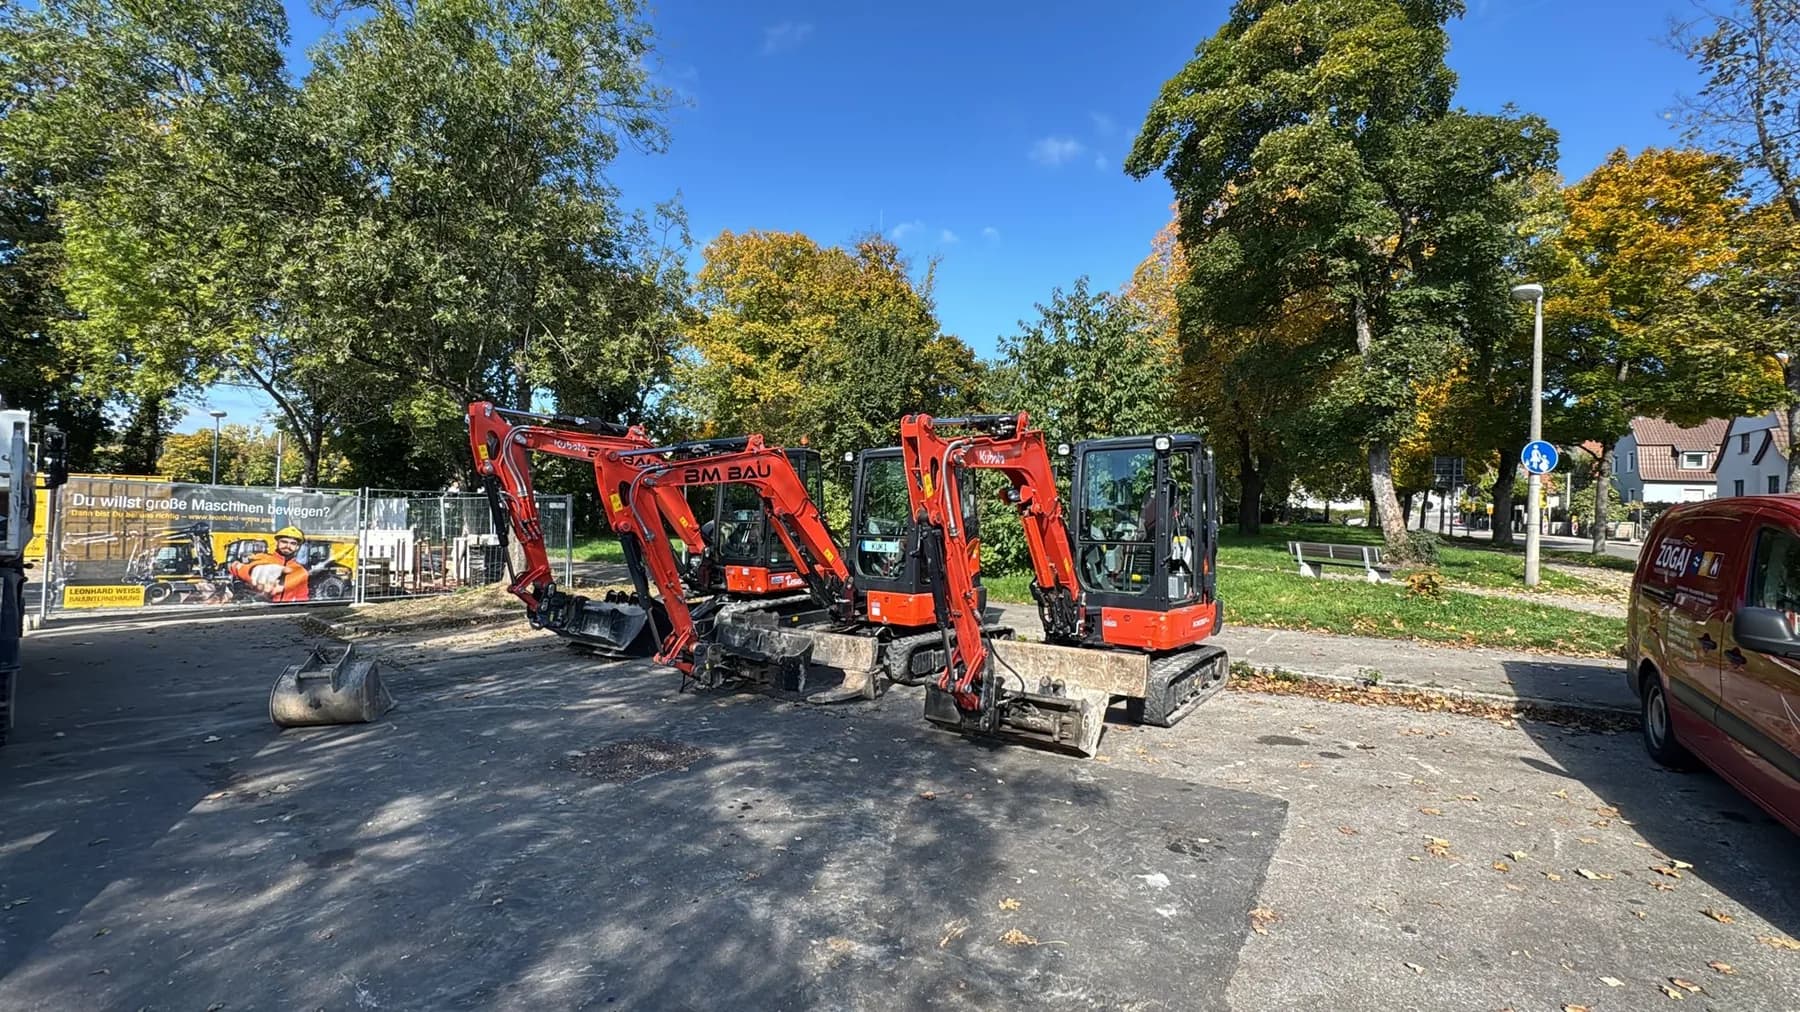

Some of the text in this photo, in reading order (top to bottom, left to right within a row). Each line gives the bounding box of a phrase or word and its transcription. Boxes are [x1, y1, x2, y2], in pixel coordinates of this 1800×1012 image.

[553, 439, 587, 452] Kubota
[684, 461, 771, 483] BM BAU
[72, 493, 331, 519] Du willst große Maschinen bewegen?
[71, 509, 94, 517] Dann
[95, 510, 110, 518] bist
[112, 510, 124, 518] Du
[155, 512, 180, 521] richtig
[1655, 544, 1693, 577] ZOGAJ
[69, 587, 142, 595] LEONHARD WEISS
